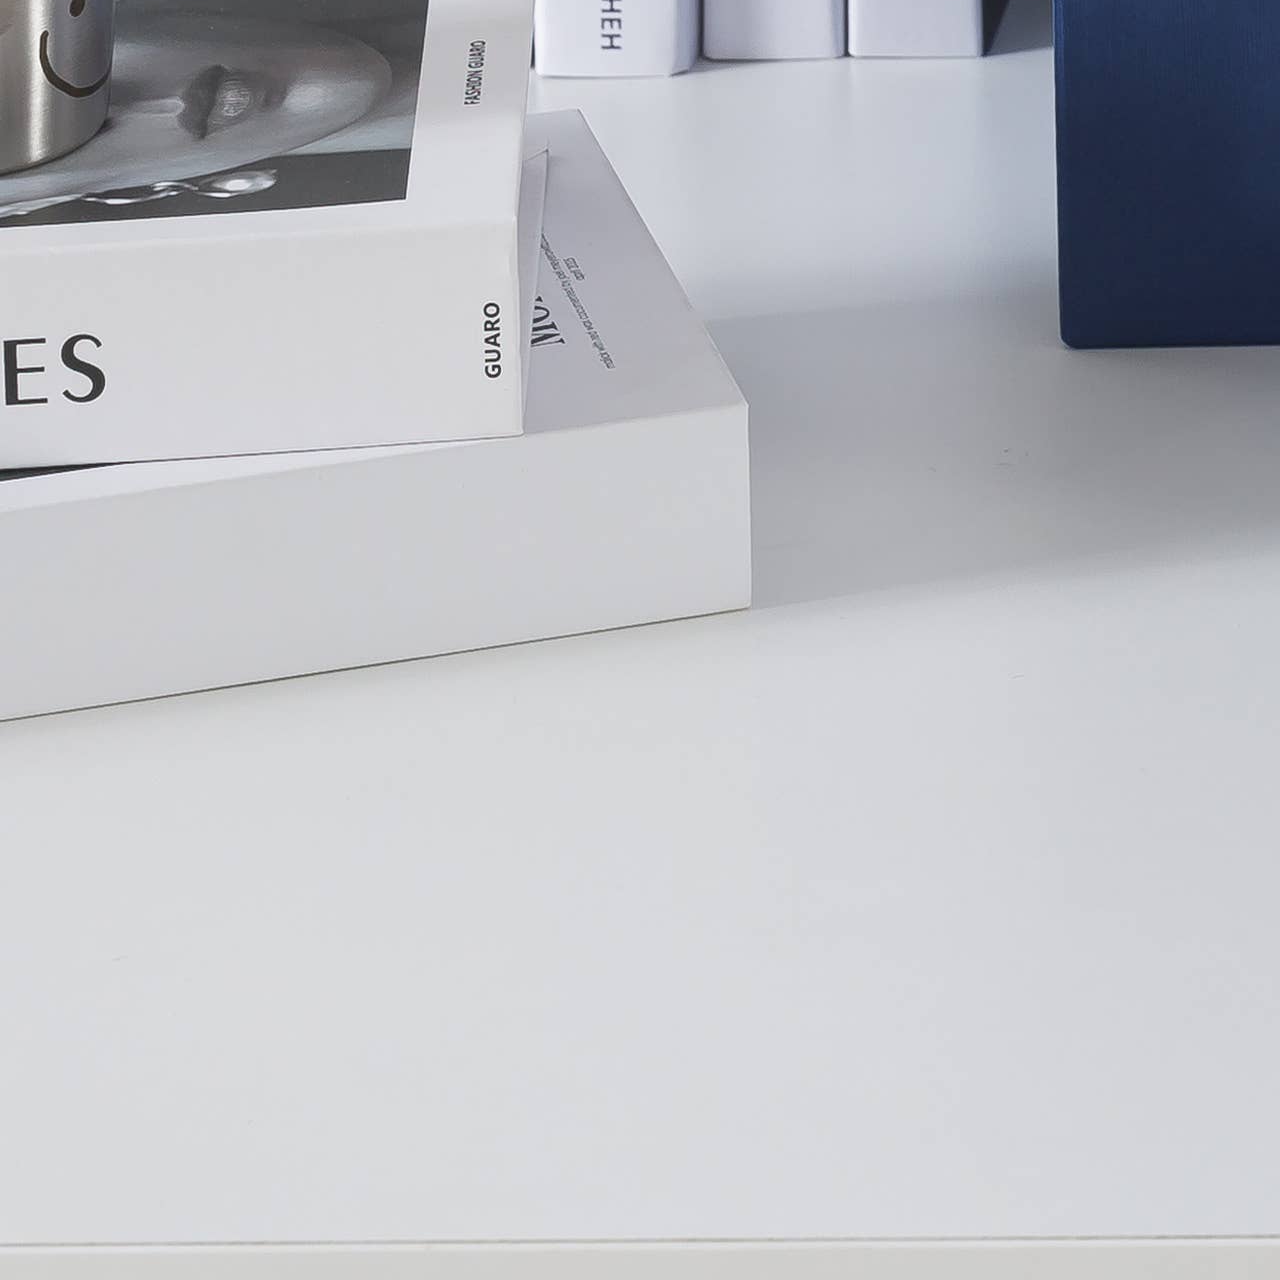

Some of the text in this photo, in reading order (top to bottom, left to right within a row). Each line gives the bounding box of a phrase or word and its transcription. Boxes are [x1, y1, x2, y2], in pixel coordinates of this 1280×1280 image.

[464, 69, 483, 105] FASHION
[3, 333, 106, 406] ES
[483, 302, 502, 379] GUARO
